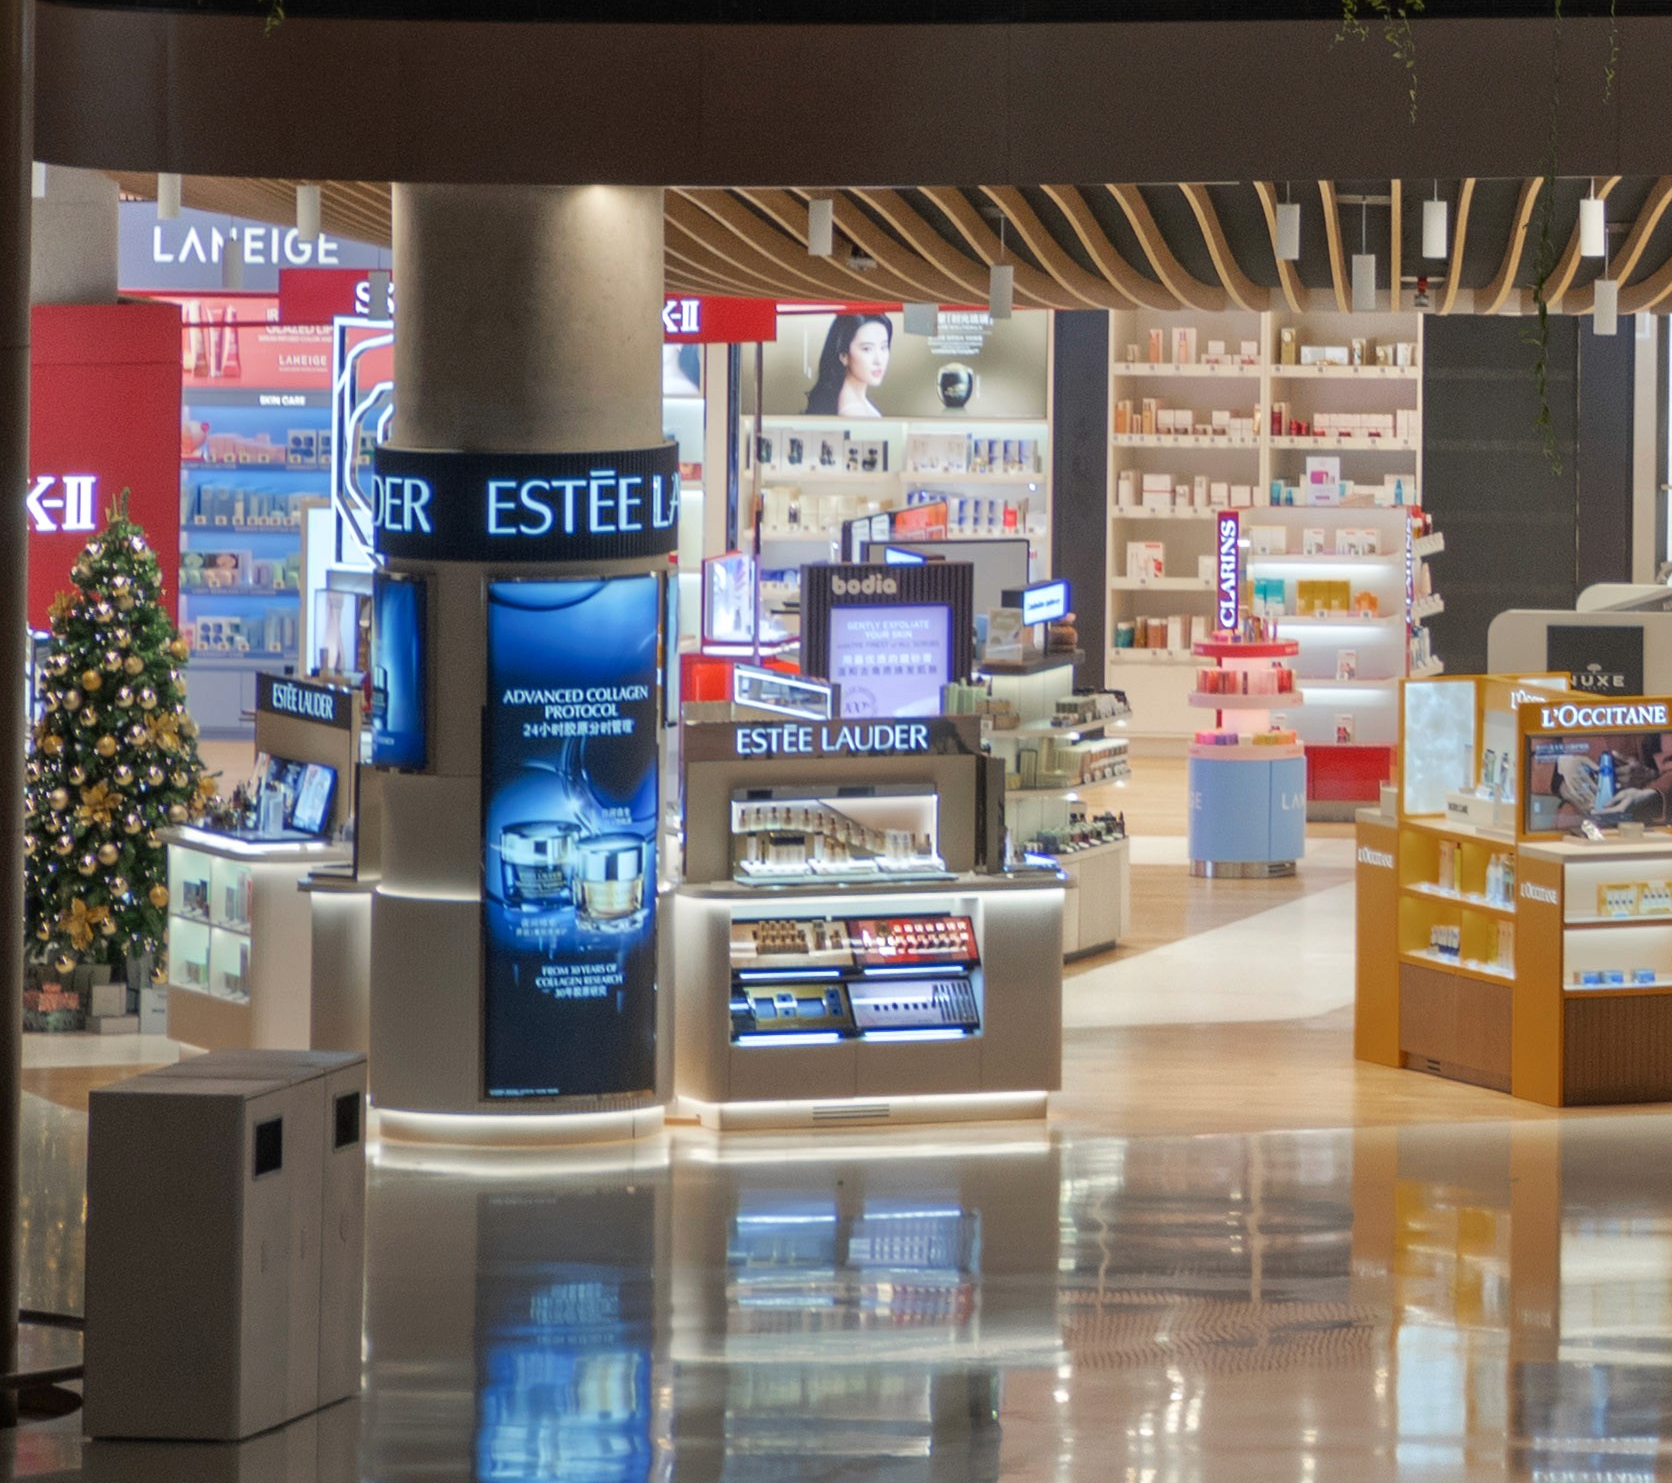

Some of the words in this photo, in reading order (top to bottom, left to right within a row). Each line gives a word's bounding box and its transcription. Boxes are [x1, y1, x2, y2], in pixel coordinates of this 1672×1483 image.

[662, 299, 700, 333] K-II
[26, 475, 97, 533] K-II
[831, 573, 897, 595] bodia
[1220, 519, 1236, 628] CLARINS
[299, 689, 334, 721] LAUDER
[502, 688, 584, 705] ADVANCED
[586, 685, 649, 703] COLLAGEN
[544, 703, 619, 720] PROTOCOL
[1541, 704, 1668, 729] L'OCCITANE
[822, 723, 928, 752] LAUDER
